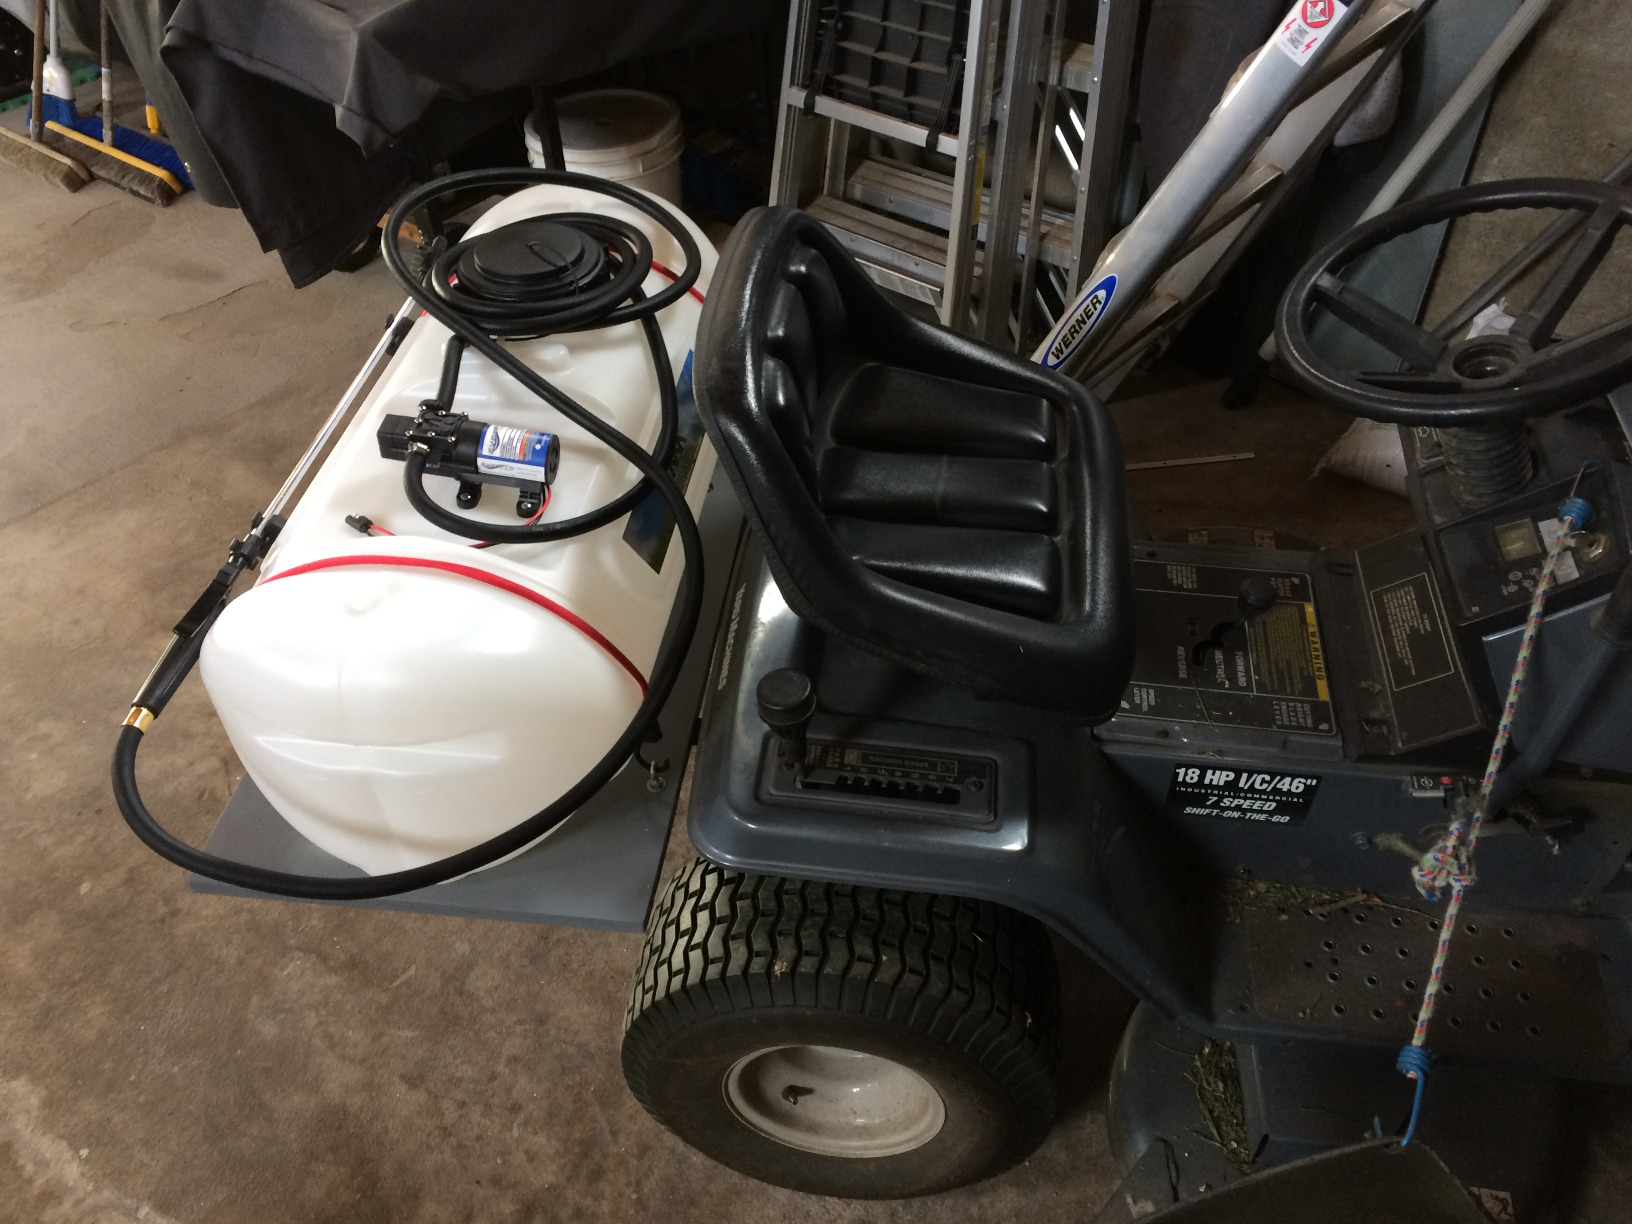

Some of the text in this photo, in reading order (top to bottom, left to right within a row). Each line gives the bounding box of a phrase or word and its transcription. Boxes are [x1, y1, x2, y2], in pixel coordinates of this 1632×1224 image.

[1050, 294, 1103, 361] WERNER
[1176, 645, 1188, 679] REVERSE
[1309, 631, 1324, 681] WARNING
[1234, 651, 1247, 687] FORWARD
[1133, 687, 1141, 704] LEVER
[1141, 688, 1150, 712] CONTROL
[1148, 689, 1156, 706] SPEED
[1272, 700, 1282, 726] LEVER
[1280, 701, 1290, 726] ENGAGE
[1288, 702, 1298, 725] BLADE
[1295, 702, 1306, 727] HEIGHT
[1303, 703, 1314, 728] CUTTING
[1175, 767, 1318, 794] 18 HP I/C/46"
[1175, 786, 1305, 803] INDUSTRIAL/COMMERCIAL
[1205, 796, 1277, 812] 7 SPEED
[1183, 806, 1291, 824] SHIFT-ON-THE-GO
